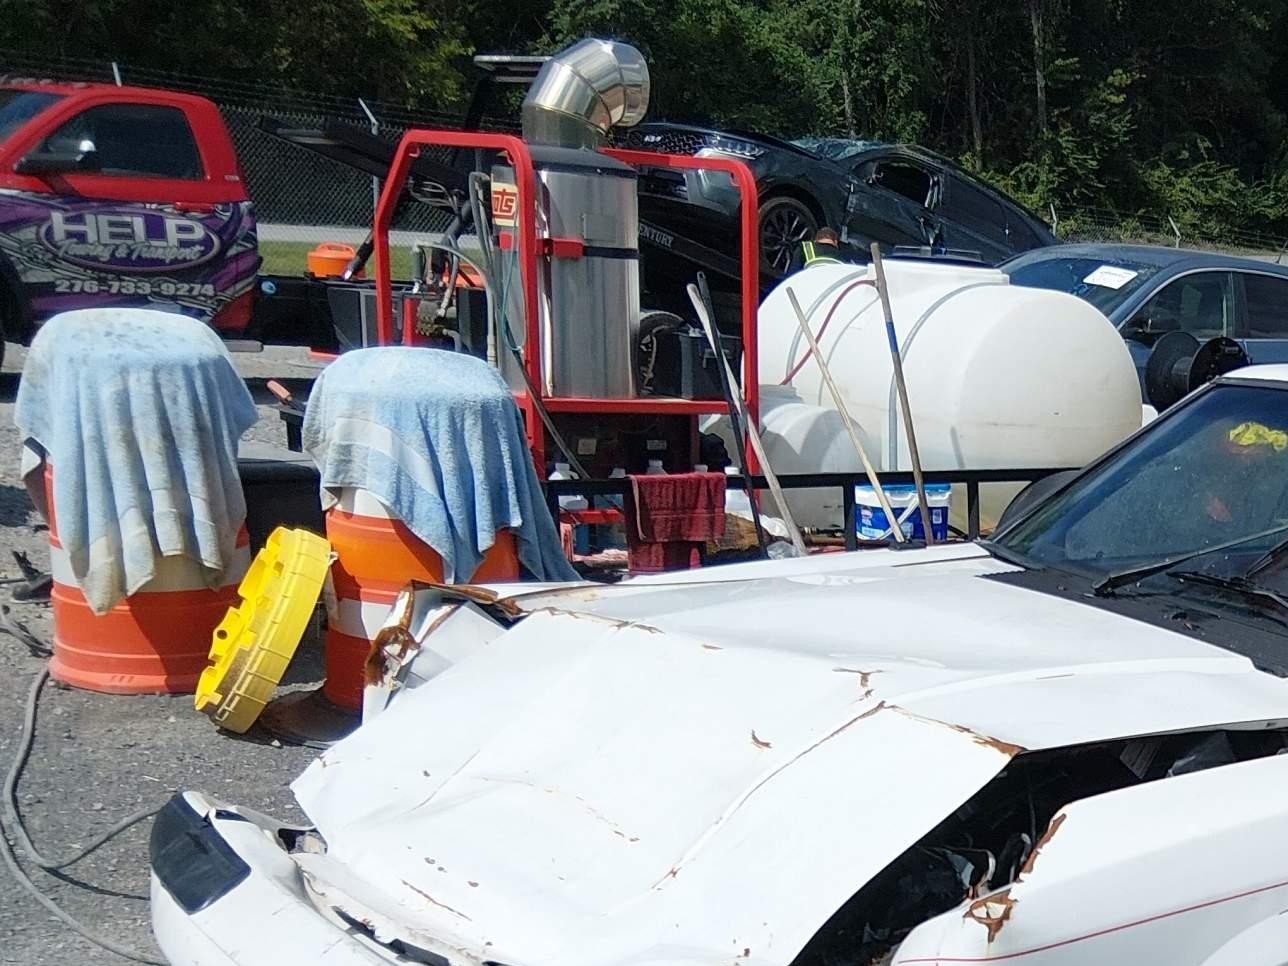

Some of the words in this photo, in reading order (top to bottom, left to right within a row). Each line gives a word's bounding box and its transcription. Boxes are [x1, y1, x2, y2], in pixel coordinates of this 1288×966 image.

[51, 212, 206, 248] HELP
[57, 239, 116, 261] Towing
[114, 242, 130, 258] &
[131, 243, 205, 263] Transport
